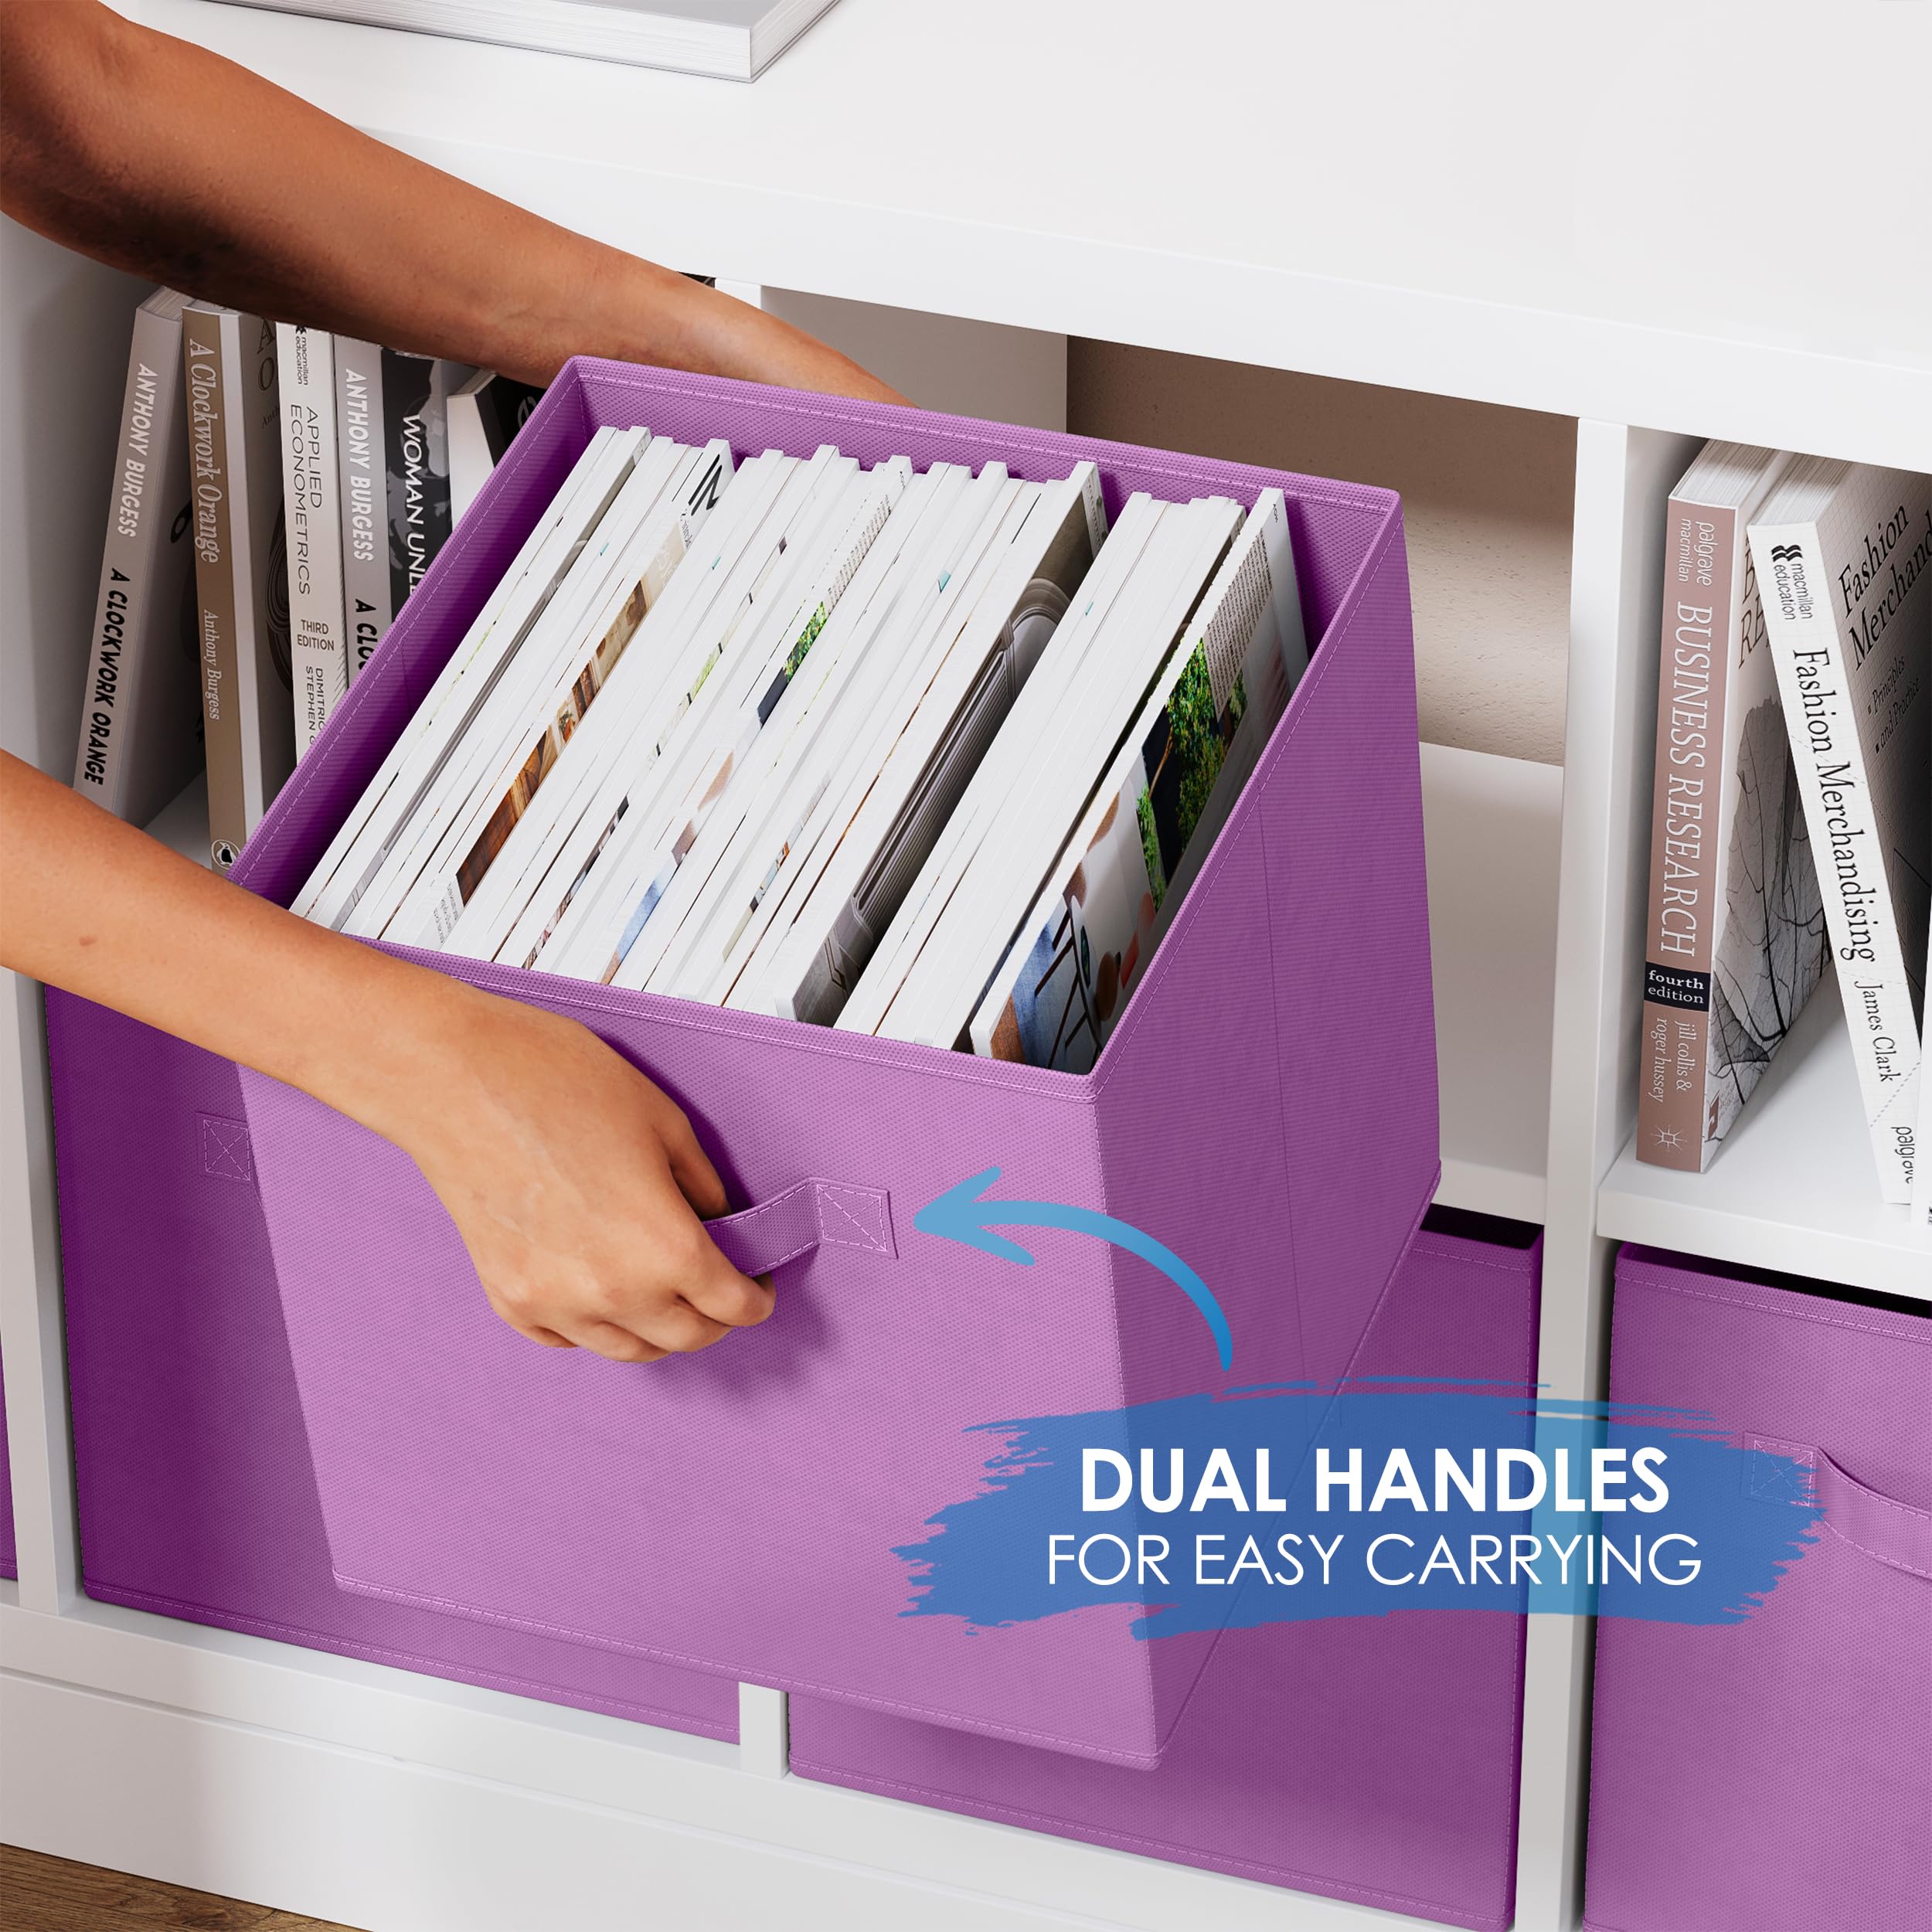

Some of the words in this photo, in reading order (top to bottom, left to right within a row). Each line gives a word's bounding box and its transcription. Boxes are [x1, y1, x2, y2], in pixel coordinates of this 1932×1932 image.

[189, 338, 216, 357] A
[301, 336, 309, 386] macmillan
[129, 363, 158, 456] ANTHONY
[191, 362, 221, 481] Clockwork
[345, 368, 370, 469] ANTHONY
[307, 406, 322, 509] APPLIED
[402, 414, 425, 525] WOMAN
[117, 458, 146, 538] BURGESS
[195, 483, 223, 563] Orange
[291, 403, 311, 595] ECONOMETRICS
[349, 475, 374, 562] BURGESS
[111, 567, 131, 583] A
[1679, 518, 1693, 583] macmillan
[1694, 521, 1715, 587] palgrave
[1838, 505, 1909, 619] Fashion
[355, 598, 376, 613] A
[1773, 563, 1796, 620] education
[1791, 563, 1813, 619] macmillan
[94, 590, 128, 708] CLOCKWORK
[203, 608, 219, 666] Anthony
[297, 634, 335, 651] EDITION
[301, 619, 329, 634] THIRD
[204, 668, 223, 720] Burgess
[305, 665, 316, 730] STEPHEN
[1668, 601, 1713, 769] BUSINESS
[1872, 655, 1905, 715] Principles
[1879, 709, 1893, 749] and
[1893, 678, 1920, 727] Practice
[83, 712, 112, 786] ORANGE
[1792, 648, 1837, 754] Fashion
[1816, 761, 1879, 962] Merchandising
[1660, 774, 1705, 957] RESEARCH
[1648, 970, 1704, 990] fourth
[1648, 986, 1704, 1004] edition
[1650, 1017, 1668, 1054] roger
[1675, 1020, 1697, 1040] jill
[1677, 1043, 1696, 1077] collis
[1855, 981, 1883, 1032] James
[1872, 1036, 1901, 1083] Clark
[1648, 1056, 1672, 1103] hussey
[1675, 1080, 1692, 1091] &
